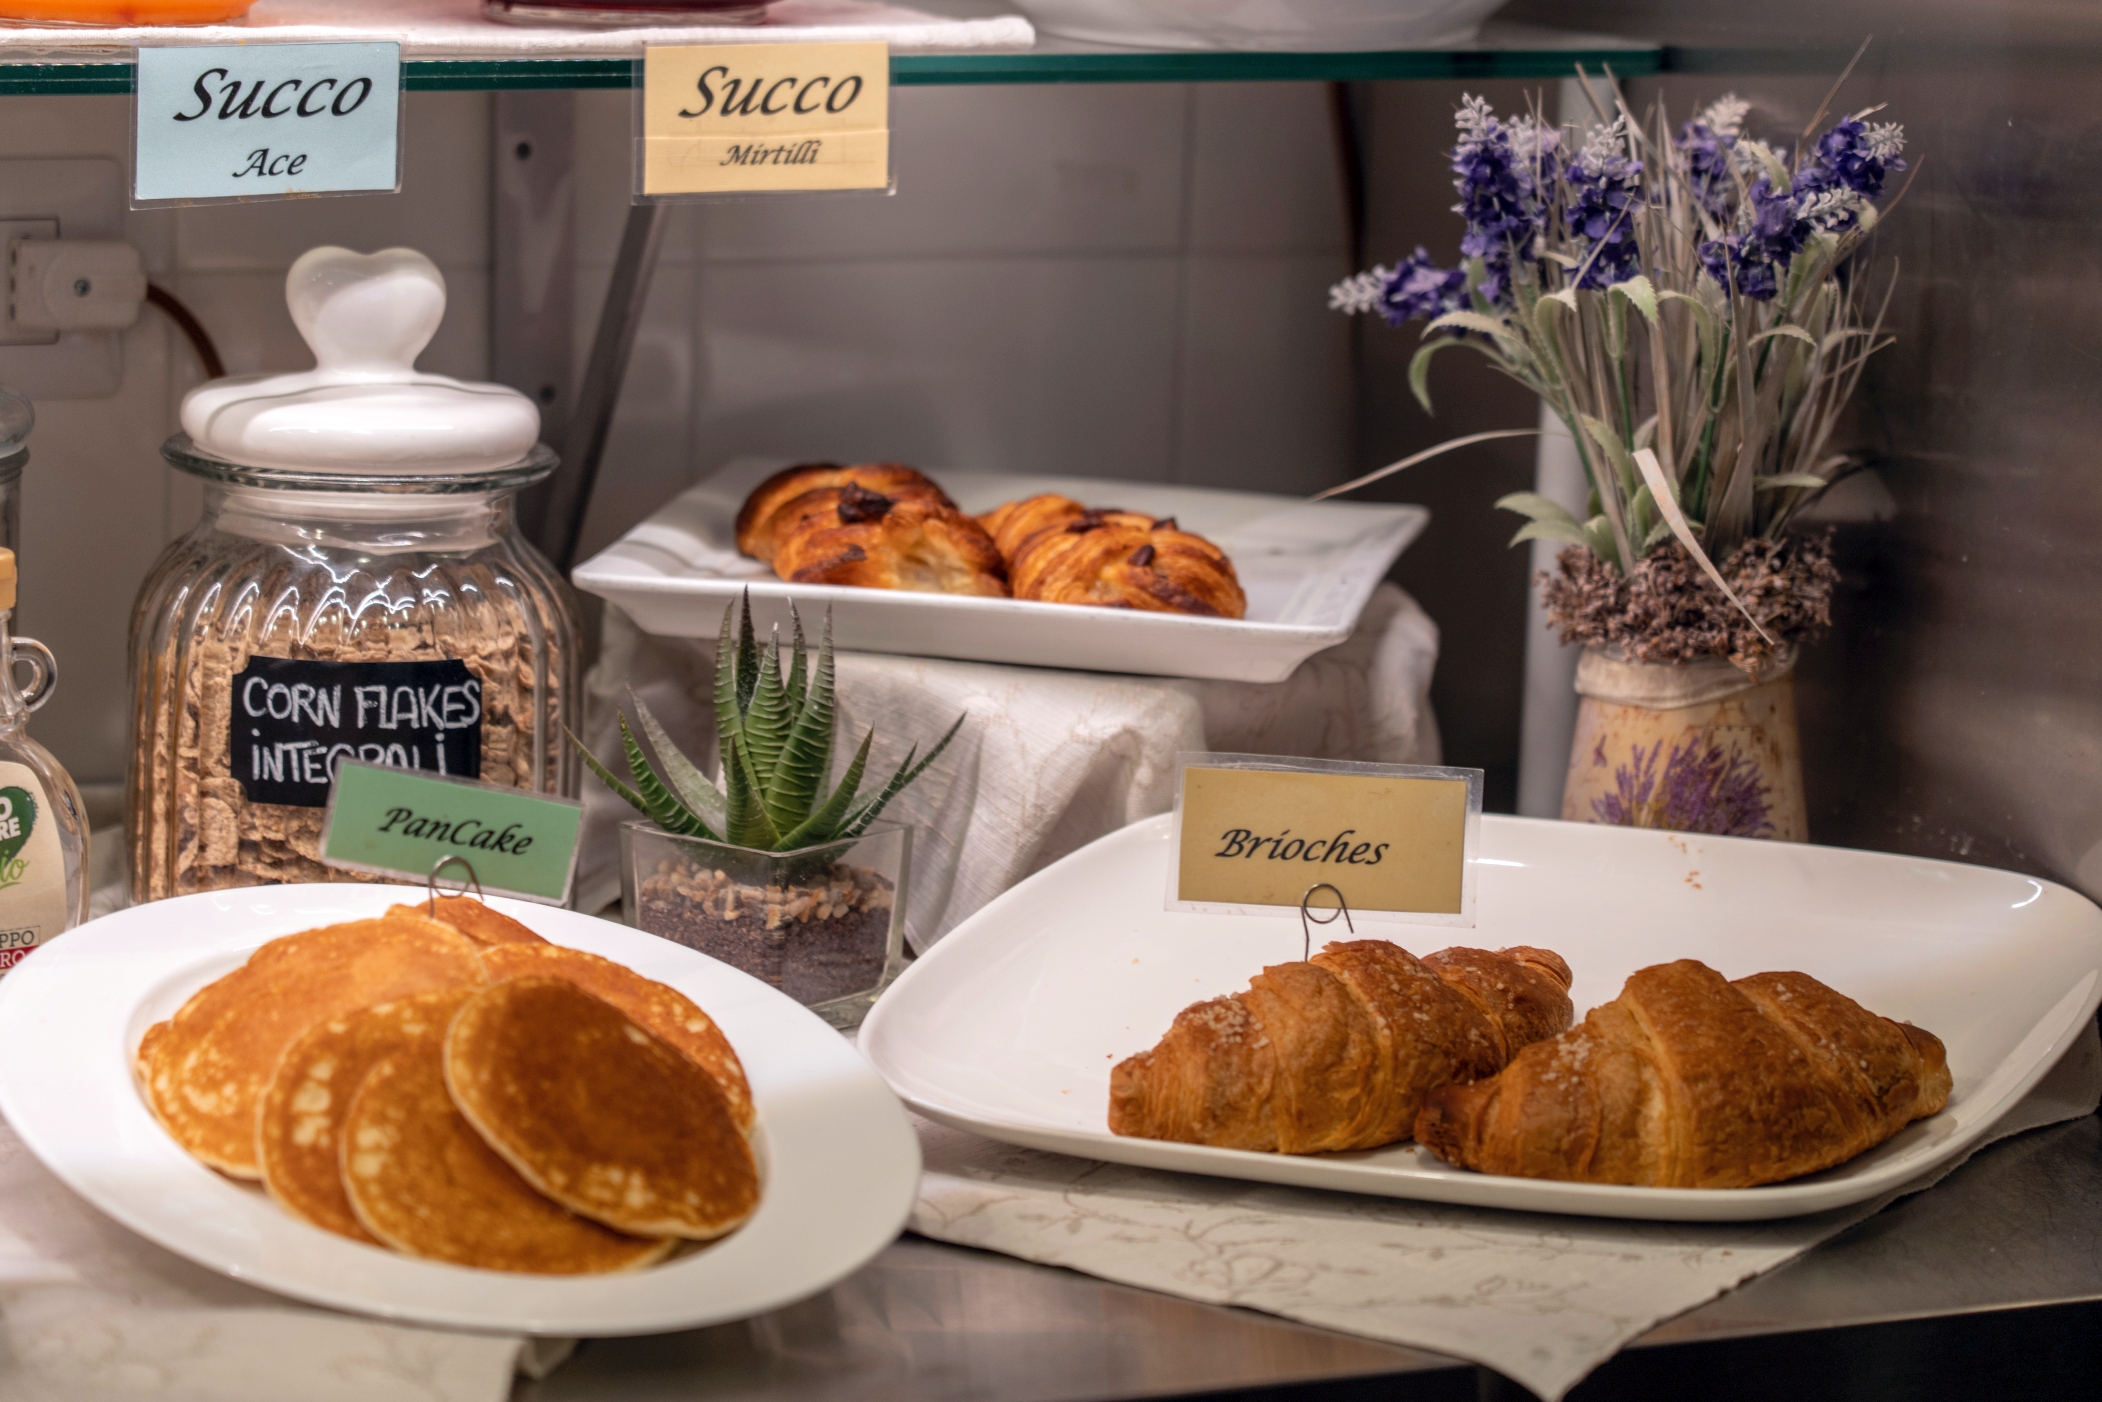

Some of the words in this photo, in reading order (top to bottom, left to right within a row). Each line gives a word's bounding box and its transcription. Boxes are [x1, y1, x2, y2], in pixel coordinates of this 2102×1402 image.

[172, 67, 373, 122] Succo
[677, 65, 863, 119] Succo
[231, 147, 308, 178] Ace
[718, 139, 823, 168] Mirtilli
[242, 676, 342, 729] CORN
[353, 679, 481, 731] FLAKES
[378, 807, 535, 857] PanCake
[1214, 828, 1390, 866] Brioches
